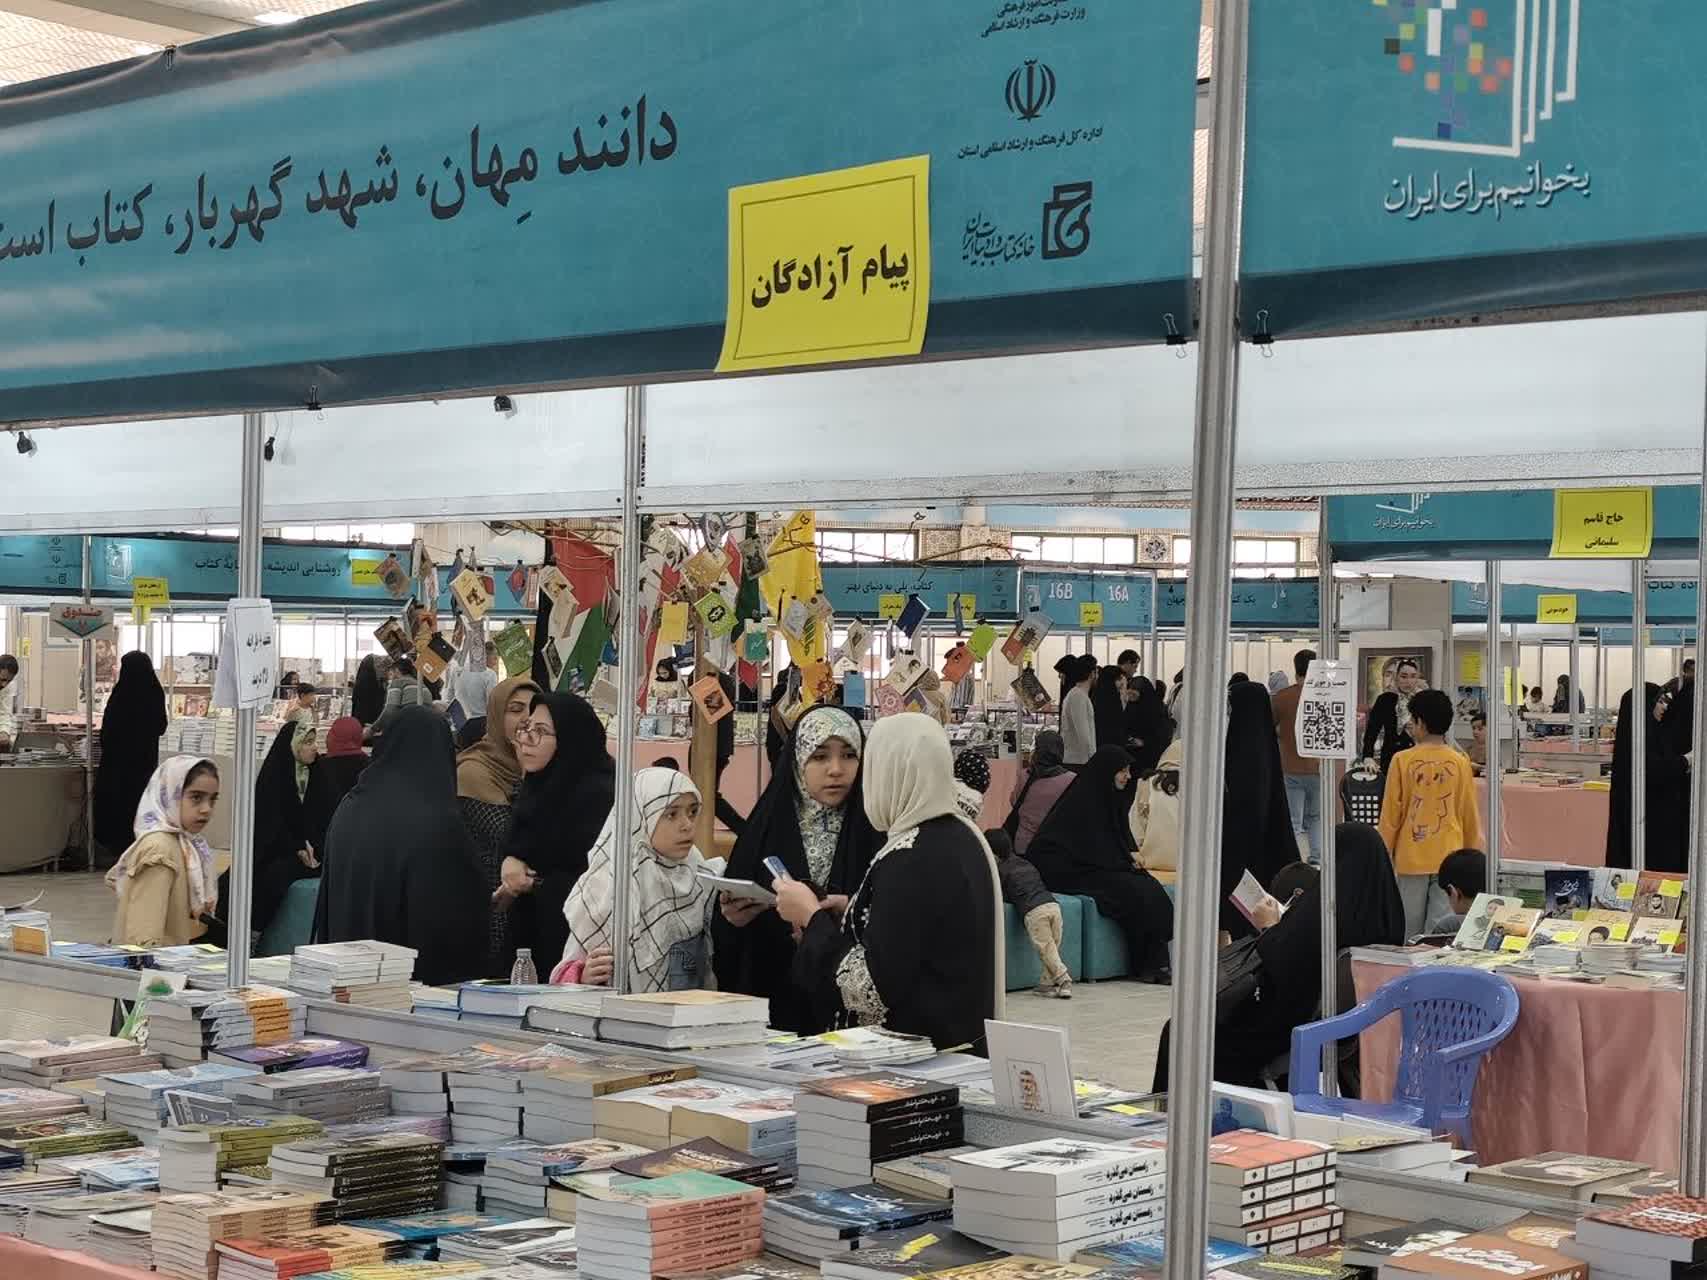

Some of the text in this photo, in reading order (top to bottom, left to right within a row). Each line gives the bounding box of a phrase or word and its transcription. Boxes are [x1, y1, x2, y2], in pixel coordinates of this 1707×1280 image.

[557, 93, 678, 176] دانند
[305, 144, 399, 229] شهد
[1383, 159, 1592, 222] بخوانیم برای ایران
[66, 182, 153, 267] کتاب
[750, 243, 910, 309] پیام آزادگان
[62, 607, 103, 619] صندوق
[1047, 582, 1073, 600] 16B
[1106, 584, 1129, 601] 16A
